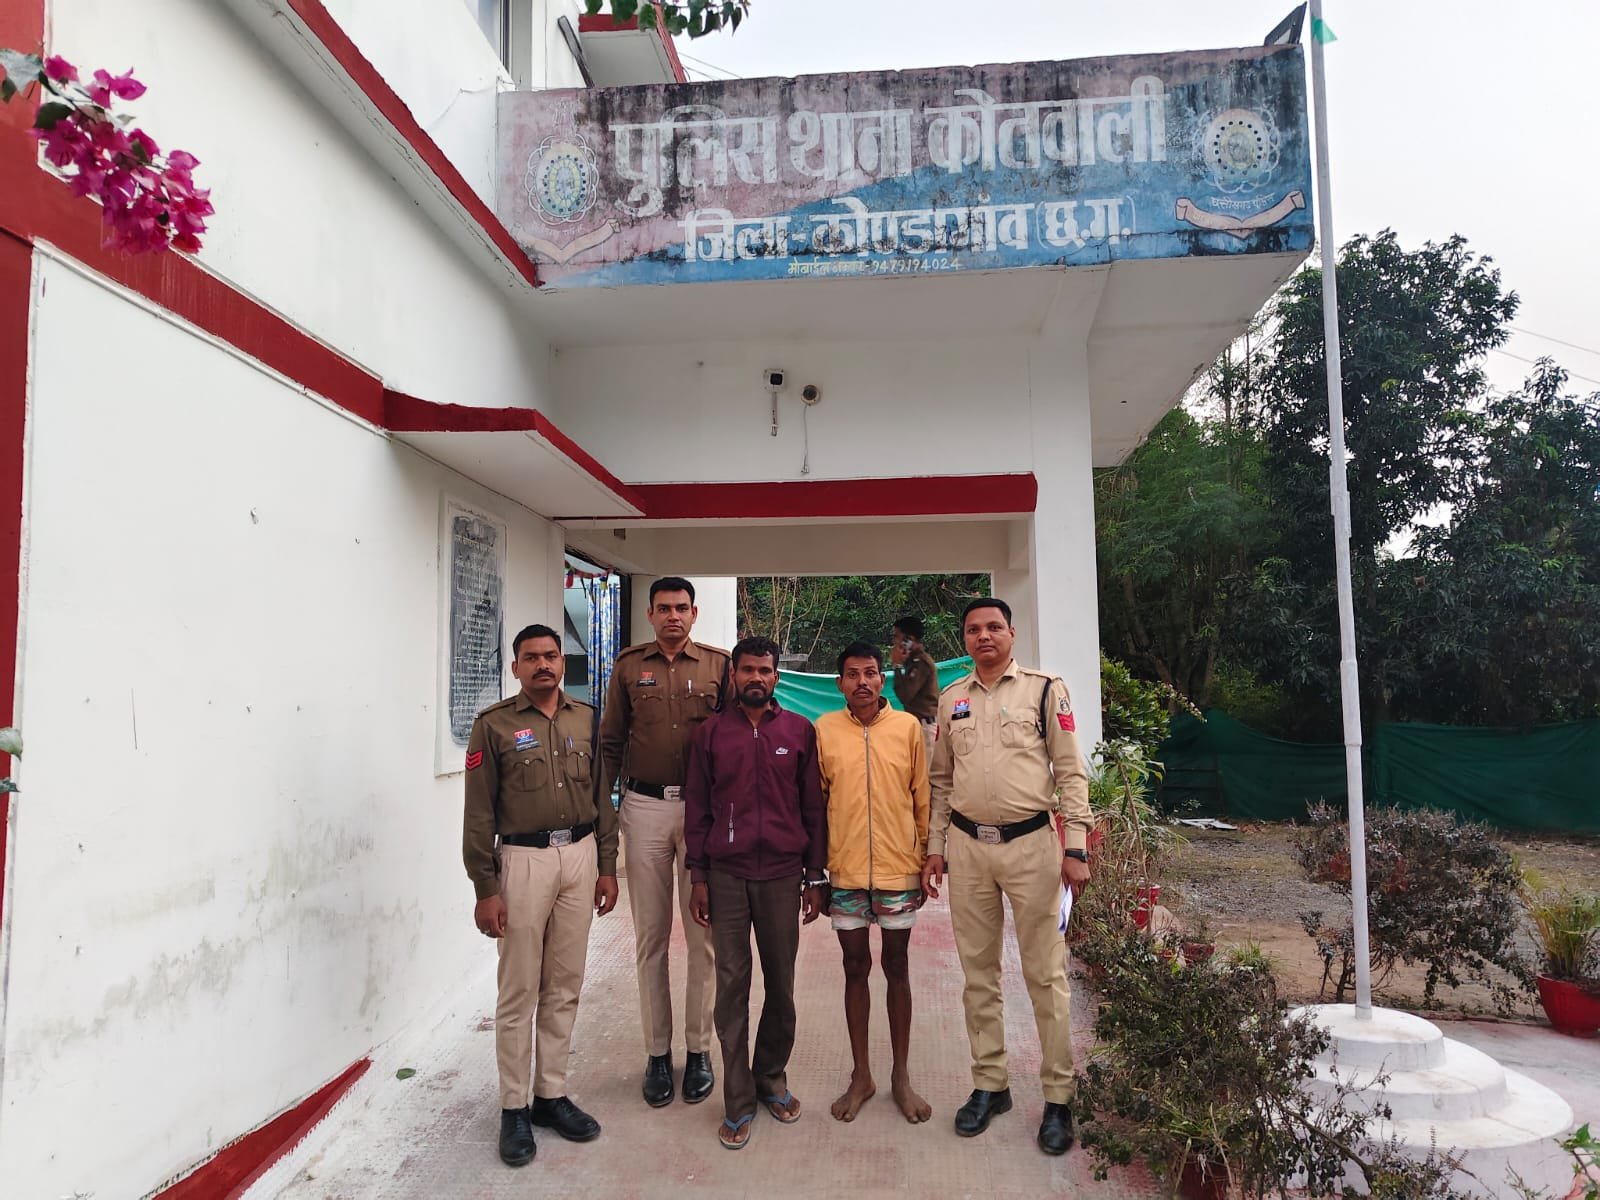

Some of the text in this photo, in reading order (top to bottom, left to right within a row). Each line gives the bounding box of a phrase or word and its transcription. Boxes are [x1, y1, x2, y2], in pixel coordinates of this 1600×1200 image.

[609, 75, 1170, 217] पुलिस थाना कोतवाली
